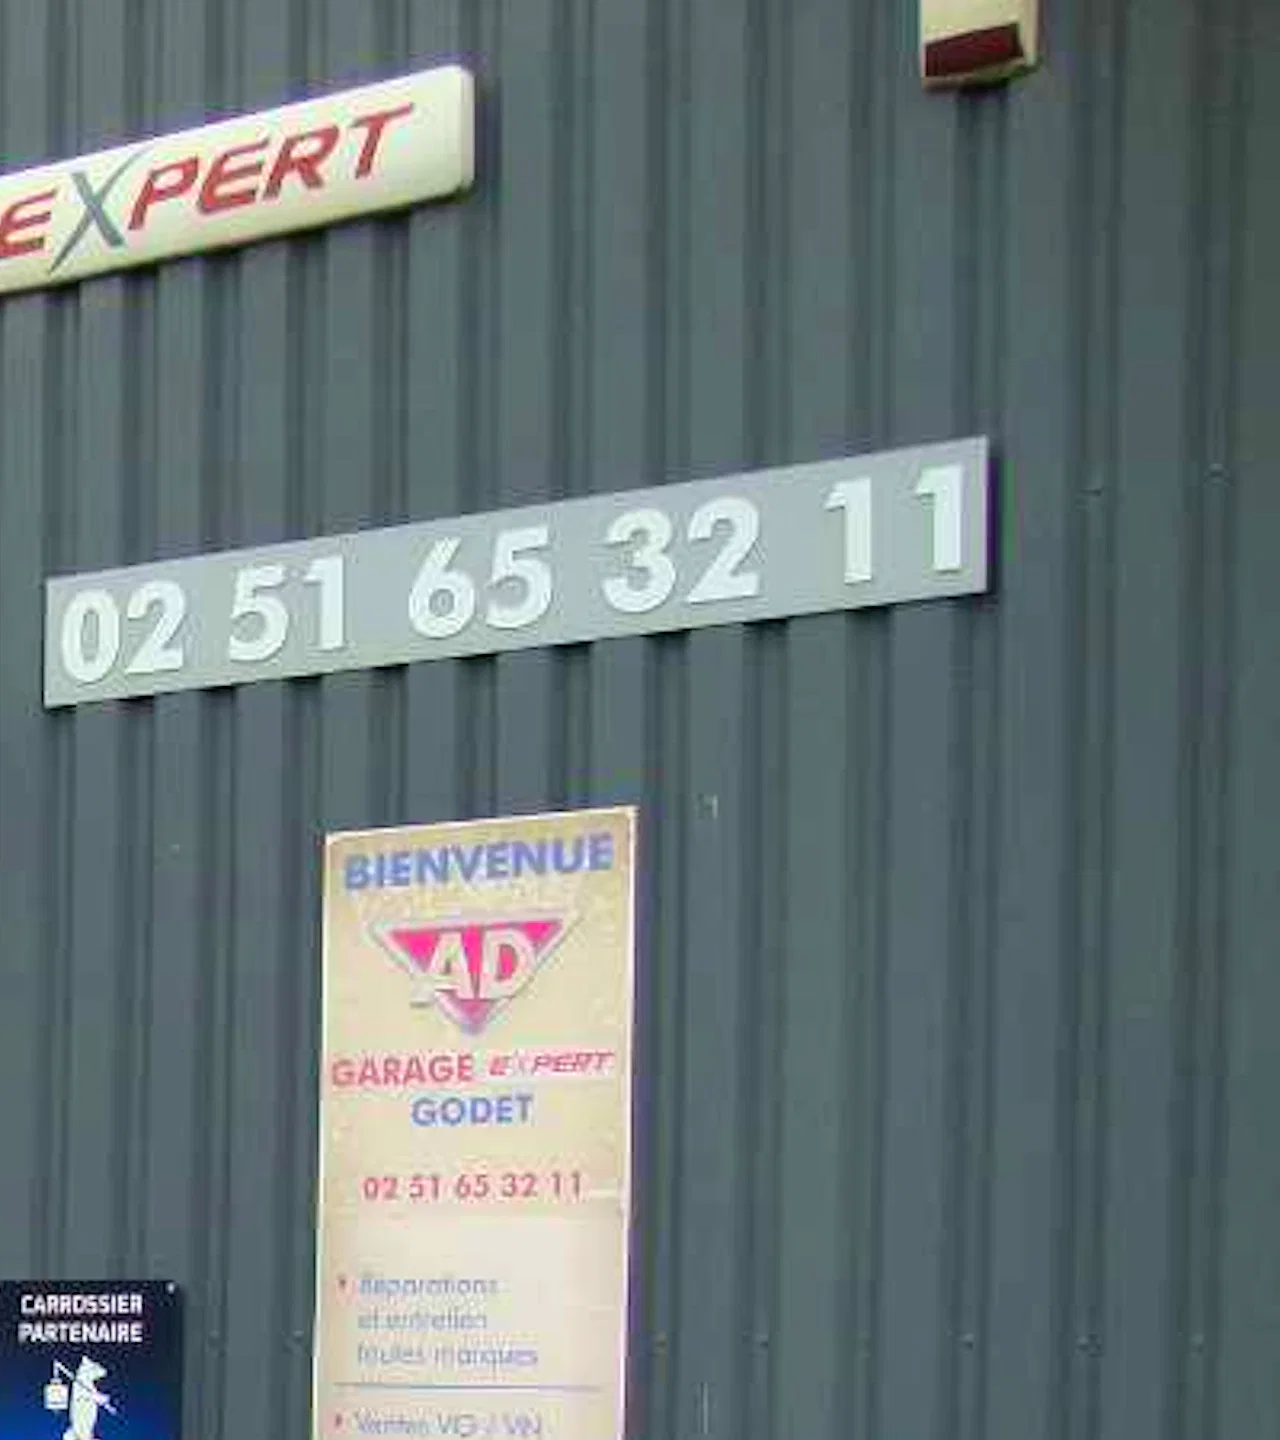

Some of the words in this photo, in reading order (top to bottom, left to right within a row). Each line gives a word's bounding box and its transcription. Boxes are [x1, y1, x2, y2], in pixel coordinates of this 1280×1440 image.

[60, 580, 186, 684] 02
[228, 555, 346, 663] 51
[408, 527, 553, 640] 65
[600, 496, 763, 615] 32
[823, 463, 965, 586] 11
[344, 832, 615, 891] BIENVENUE
[410, 926, 536, 1008] AD
[331, 1053, 475, 1087] GARAGE
[411, 1093, 534, 1127] GODET
[362, 1176, 399, 1202] 02
[408, 1175, 441, 1200] 51
[455, 1174, 490, 1199] 65
[501, 1172, 537, 1198] 32
[550, 1171, 583, 1197] 11
[20, 1294, 143, 1315] CARROSSIER
[17, 1322, 143, 1344] PARTENAIRE
